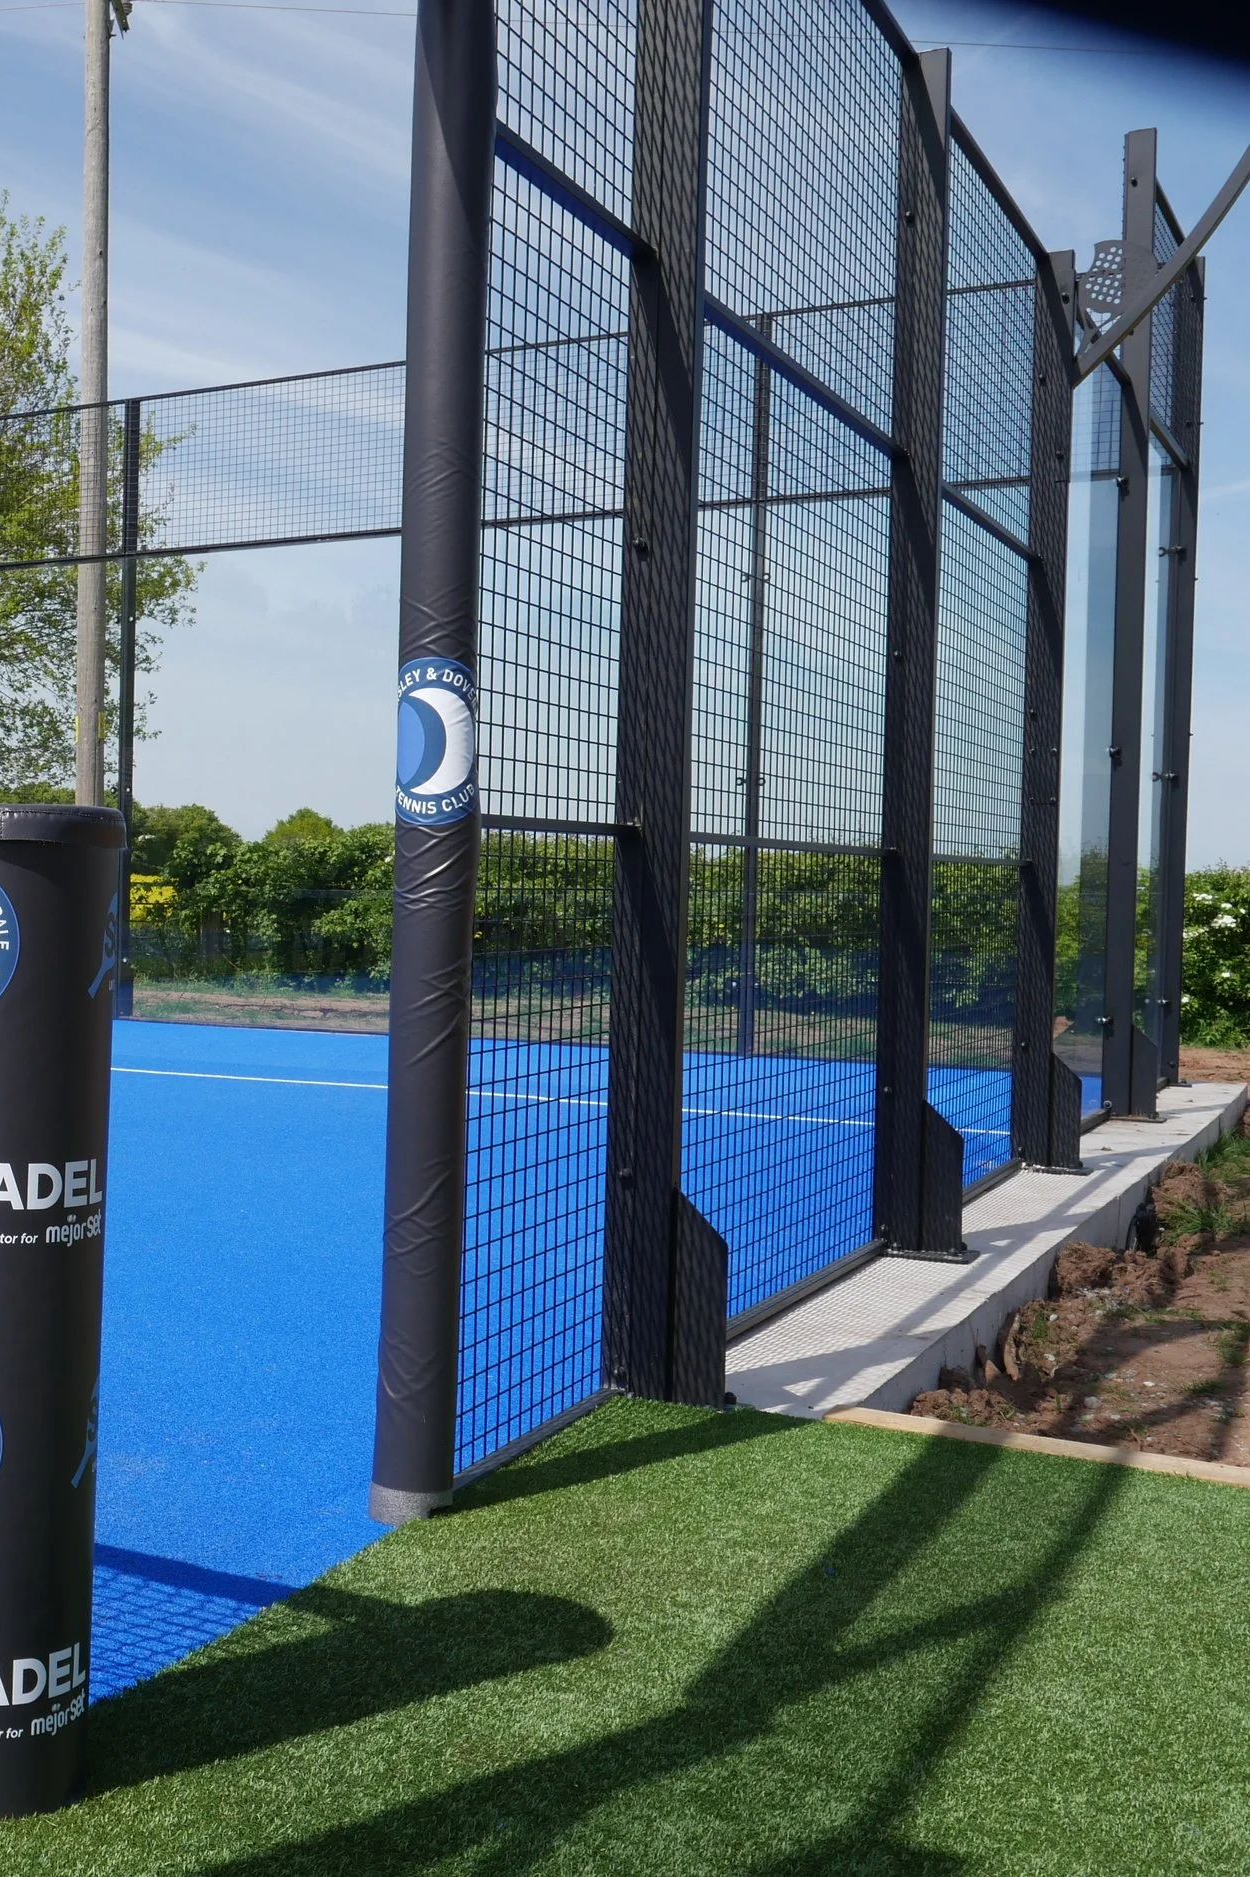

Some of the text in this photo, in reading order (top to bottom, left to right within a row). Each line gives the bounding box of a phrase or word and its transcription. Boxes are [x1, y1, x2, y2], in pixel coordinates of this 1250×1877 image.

[426, 667, 438, 681] &
[396, 783, 475, 814] TENNIS CLUB
[20, 1232, 39, 1245] for
[6, 1727, 24, 1739] for
